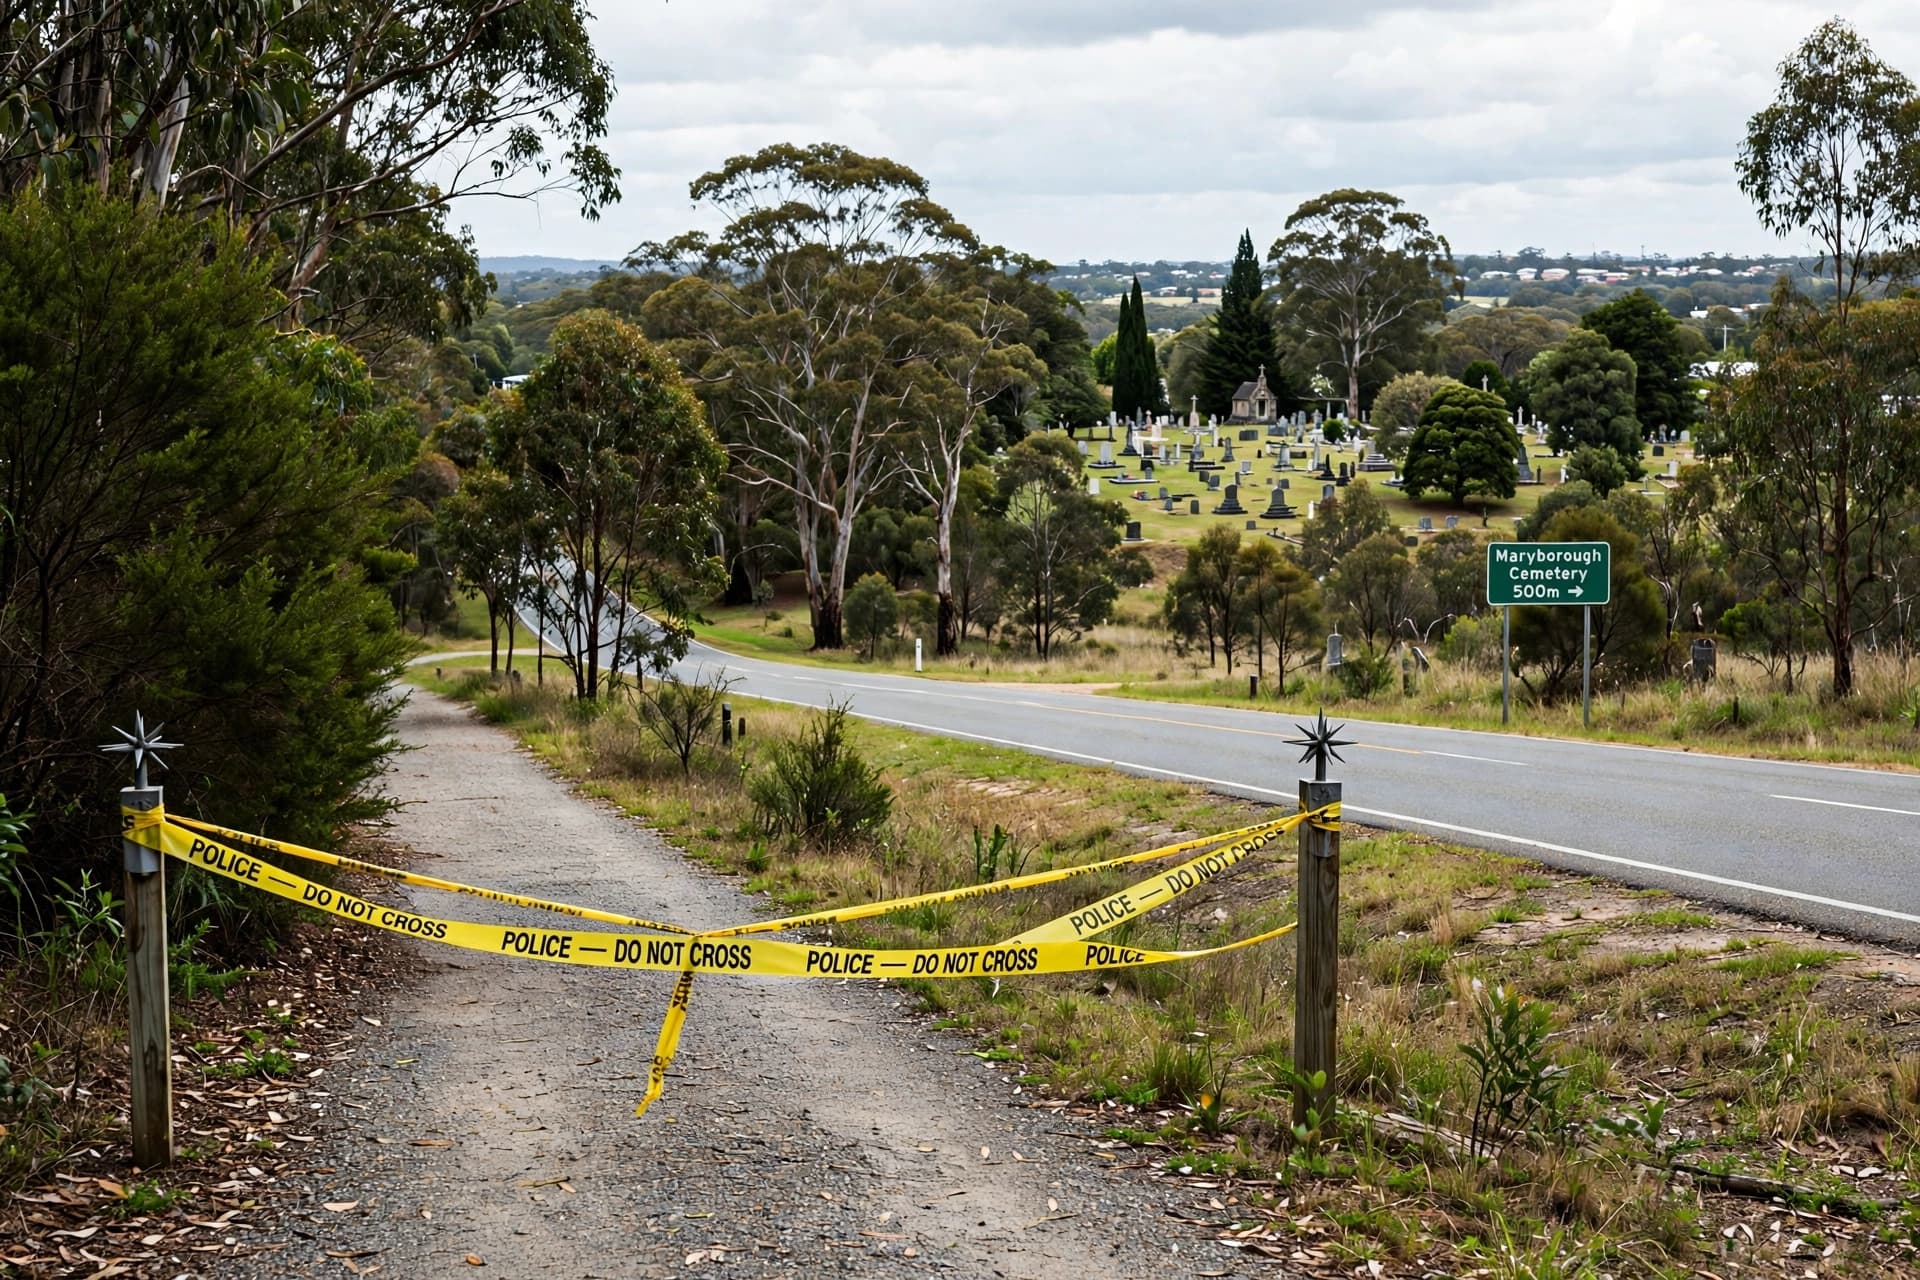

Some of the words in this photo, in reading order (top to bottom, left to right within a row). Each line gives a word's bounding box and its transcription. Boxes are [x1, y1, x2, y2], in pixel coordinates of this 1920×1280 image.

[1496, 549, 1601, 565] Maryborough
[1509, 567, 1588, 583] Cemetery
[1513, 585, 1560, 598] 500m
[189, 839, 262, 882] POLICE
[303, 884, 332, 906] DO
[336, 896, 378, 920] NOT
[381, 911, 448, 938] CROSS
[1069, 895, 1136, 935] POLICE
[1165, 869, 1194, 895] DO
[1193, 851, 1229, 882] NOT
[501, 931, 572, 958] POLICE
[614, 939, 642, 963] DO
[647, 942, 685, 965] NOT
[690, 942, 751, 969] CROSS
[806, 950, 874, 974] POLICE
[912, 953, 939, 974] DO
[943, 952, 979, 974] NOT
[982, 947, 1038, 972] CROSS
